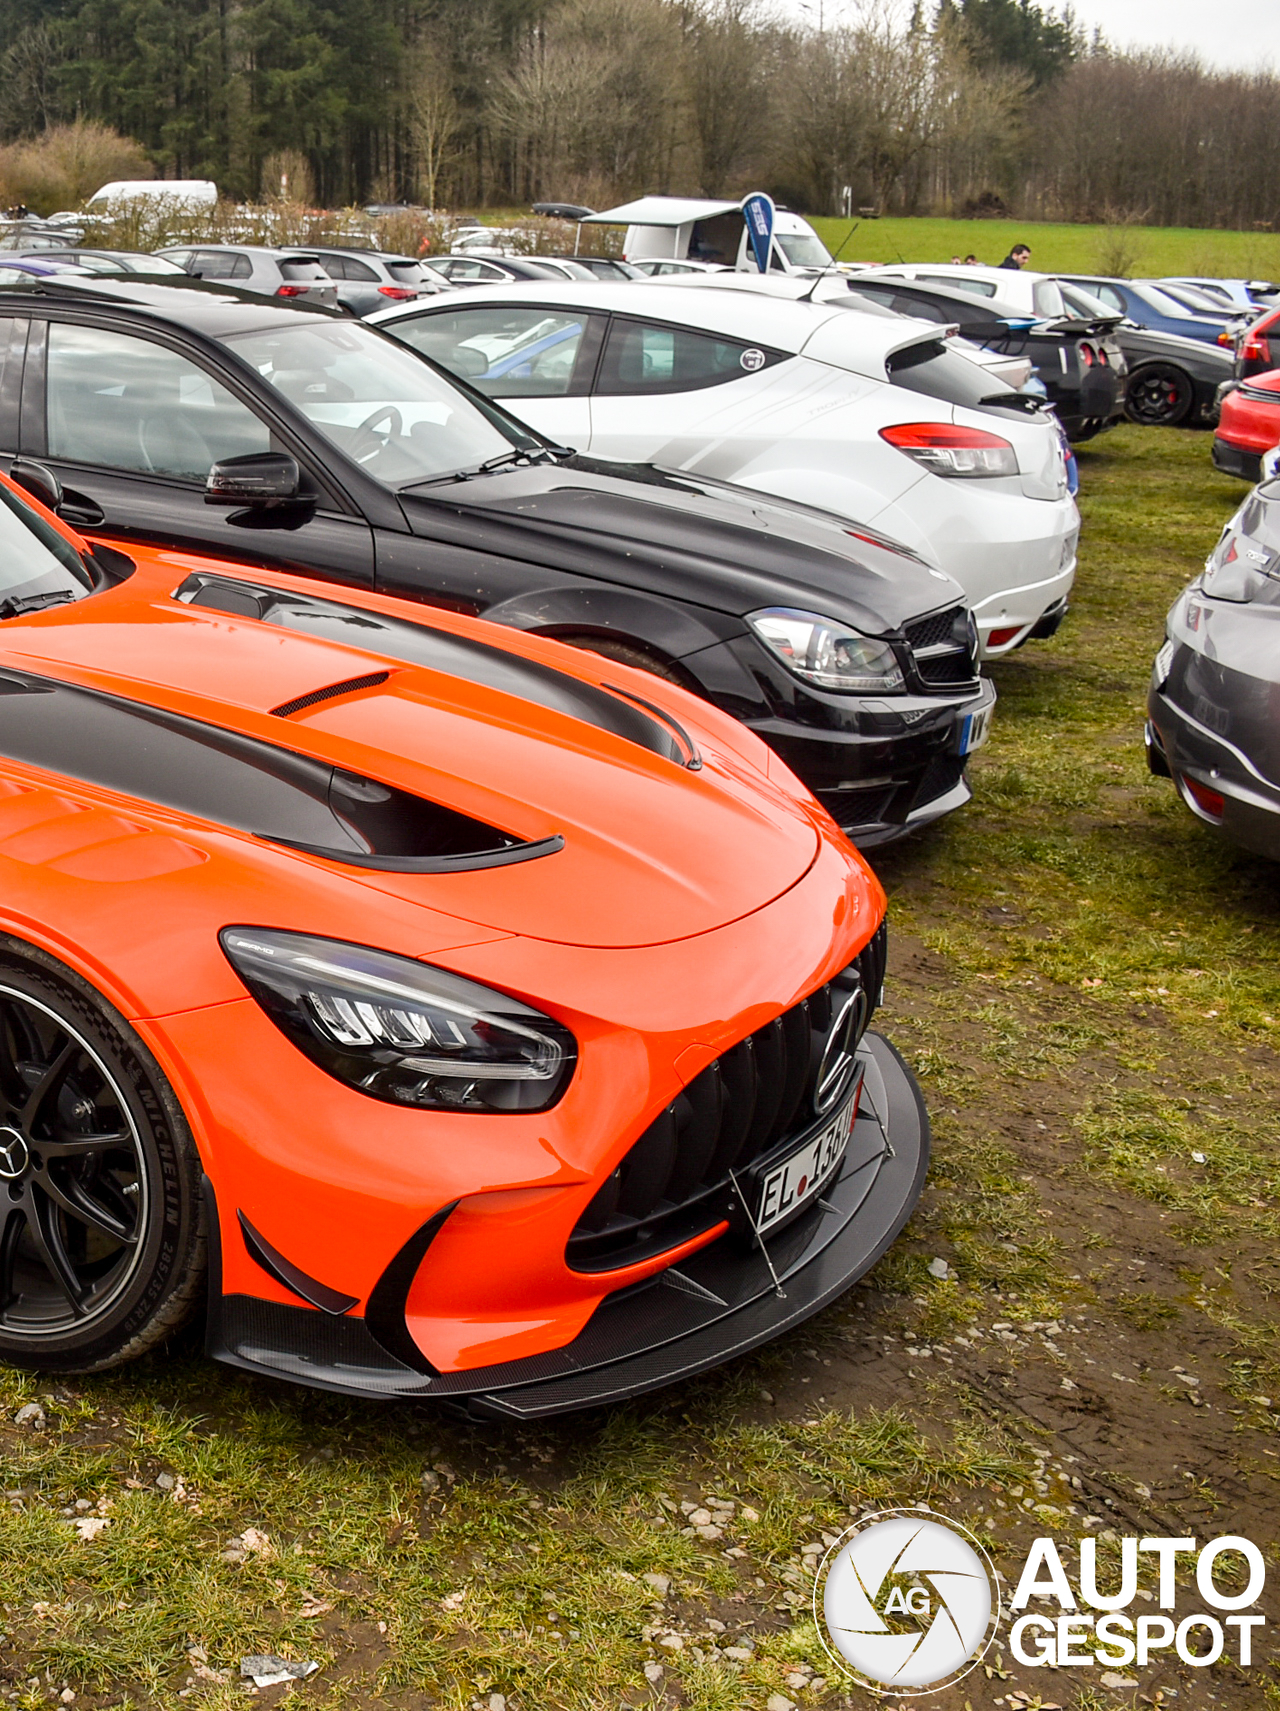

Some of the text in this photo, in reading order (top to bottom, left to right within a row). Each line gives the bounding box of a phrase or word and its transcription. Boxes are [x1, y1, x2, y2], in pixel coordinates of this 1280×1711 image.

[806, 385, 861, 416] TROPHY
[247, 943, 275, 955] AMG
[139, 1088, 179, 1227] MICHELIN
[149, 1241, 174, 1300] 285/35
[134, 1300, 151, 1319] ZR
